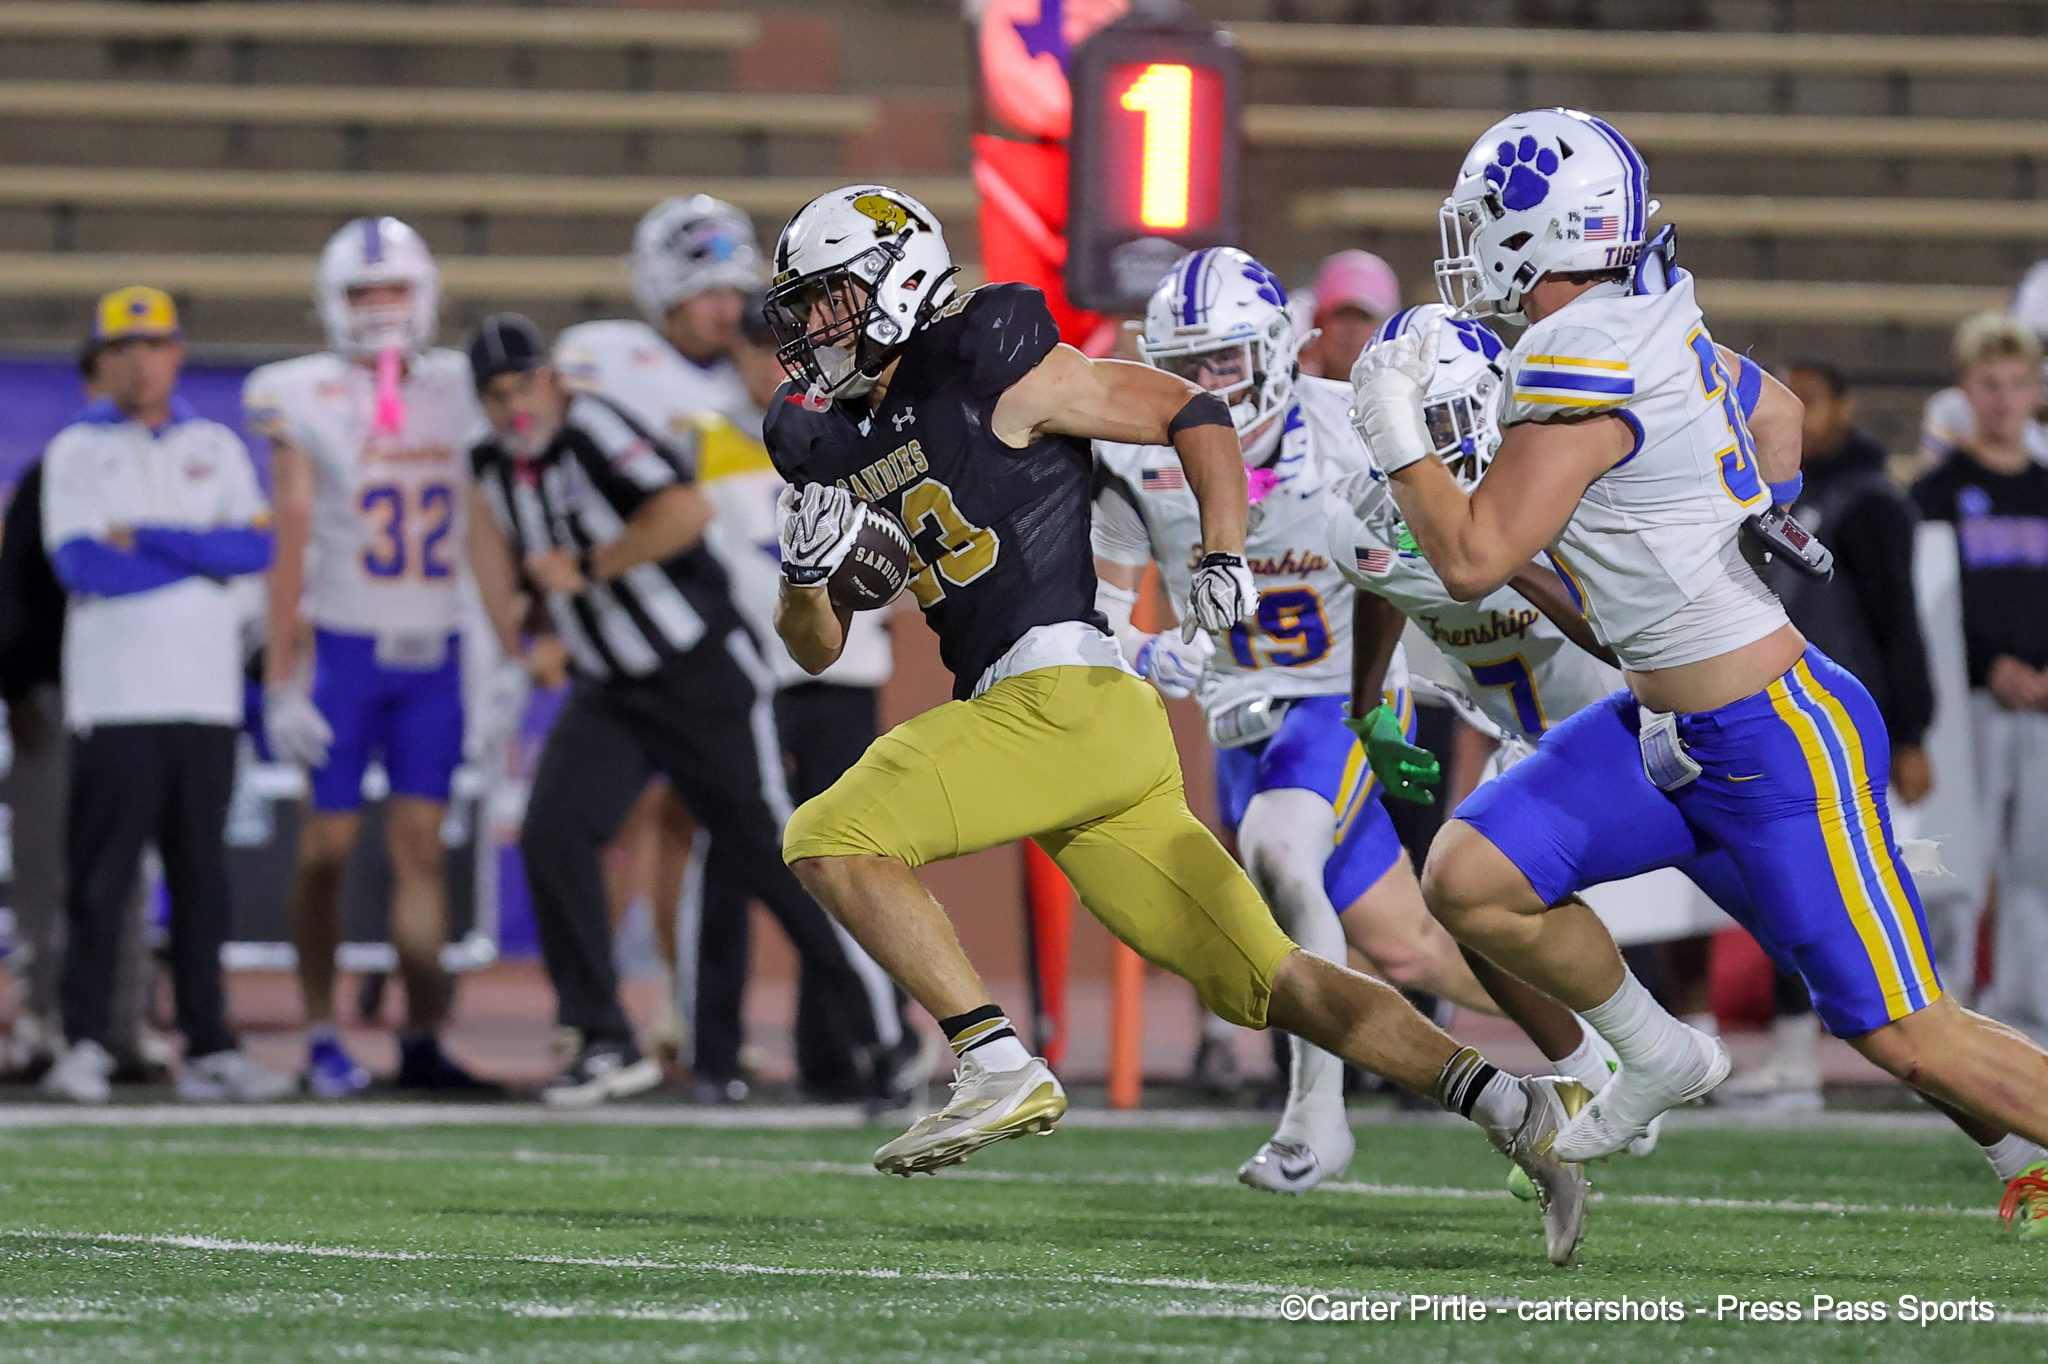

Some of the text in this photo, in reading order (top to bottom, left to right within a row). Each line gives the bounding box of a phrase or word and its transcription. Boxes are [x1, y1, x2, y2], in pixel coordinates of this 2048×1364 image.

[1121, 64, 1192, 228] 1
[1566, 229, 1580, 240] 1%
[1568, 211, 1581, 222] 1%
[1605, 244, 1645, 267] TIGE
[359, 480, 456, 584] 32
[855, 546, 901, 590] SANDIES
[1420, 608, 1539, 646] Frenship
[1466, 652, 1548, 735] 7
